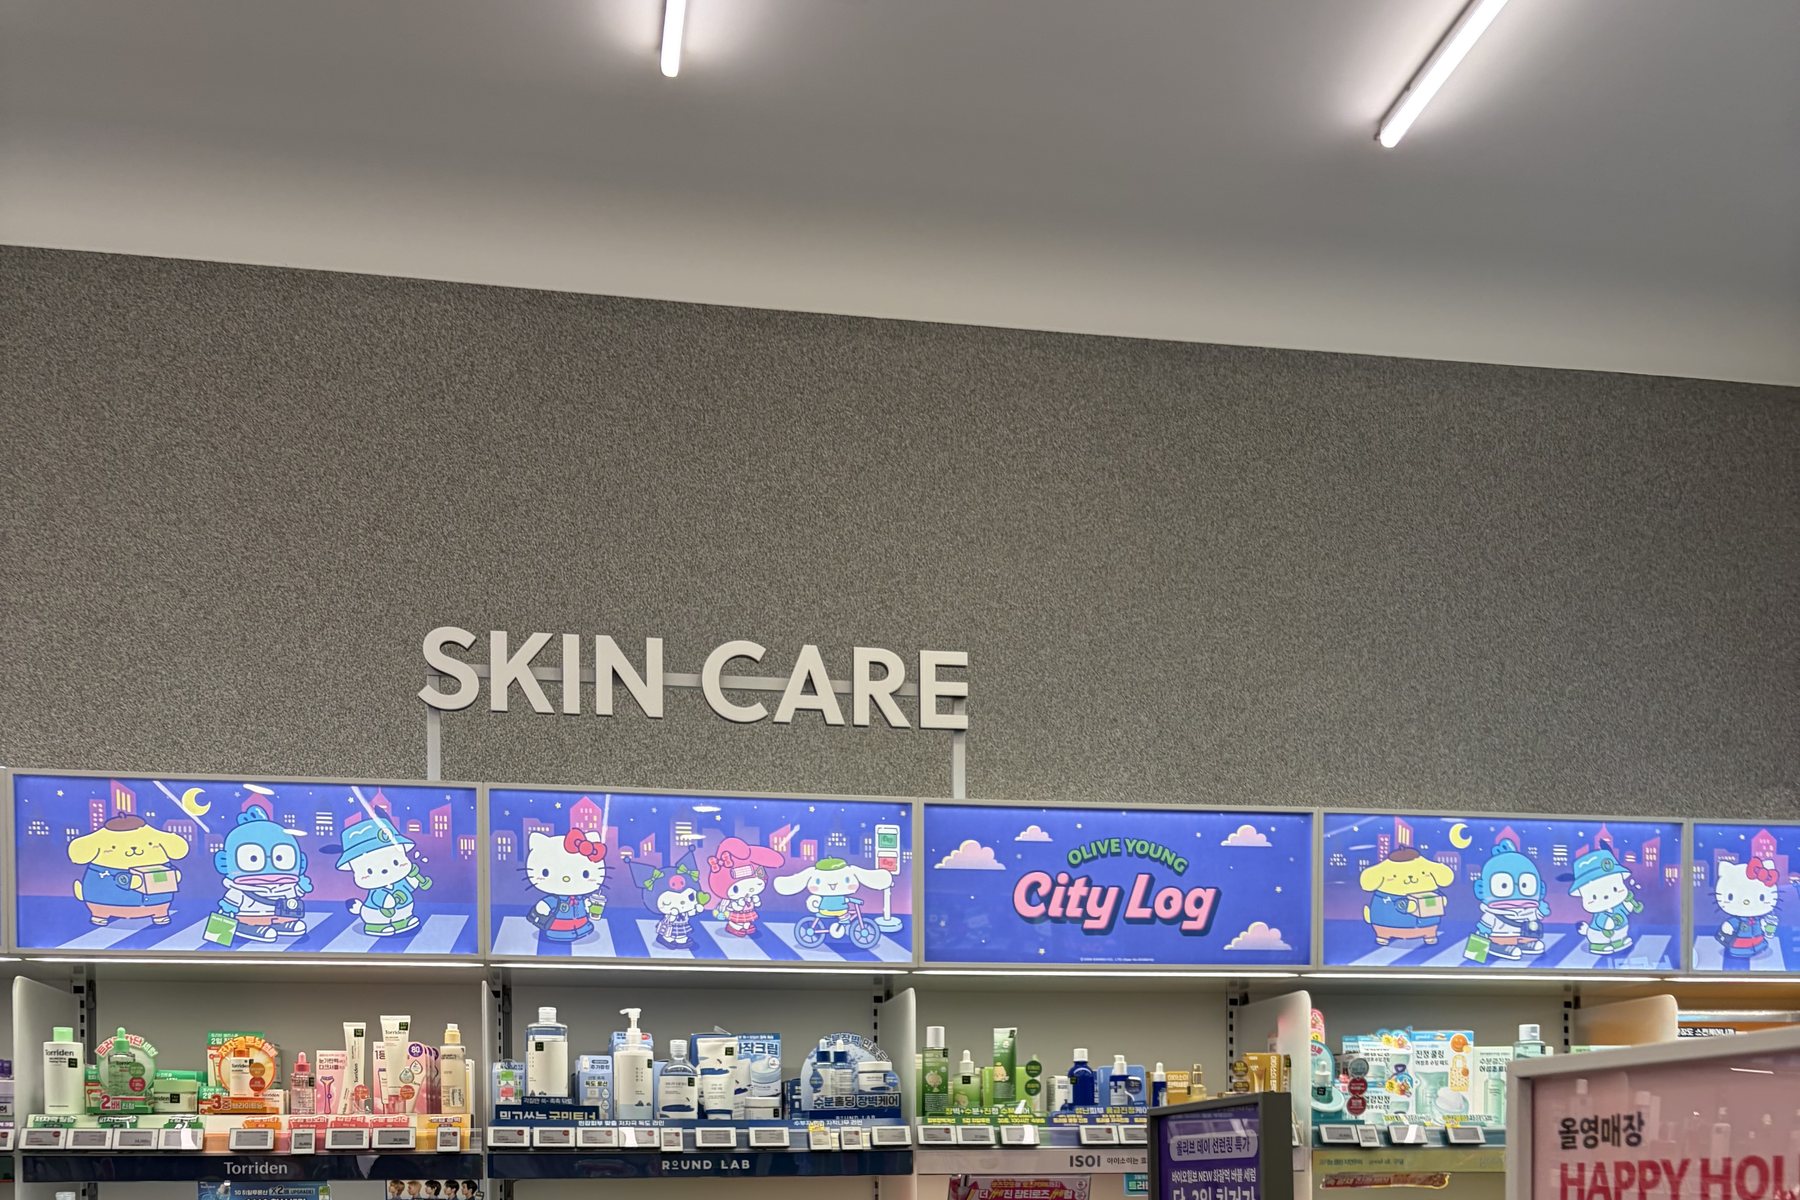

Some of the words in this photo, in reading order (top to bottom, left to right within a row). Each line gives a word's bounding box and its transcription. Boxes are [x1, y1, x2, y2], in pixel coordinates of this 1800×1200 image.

[418, 626, 663, 718] SKIN
[701, 640, 969, 730] CARE
[1067, 837, 1121, 867] OLIVE
[1124, 838, 1189, 875] YOUNG
[1013, 871, 1122, 933] City
[1124, 872, 1220, 935] Log
[1558, 1111, 1645, 1150] 올영매장
[1176, 1137, 1196, 1156] 올리브
[224, 1162, 288, 1175] Torriden
[720, 1160, 750, 1170] LAB
[1198, 1169, 1212, 1183] NEW
